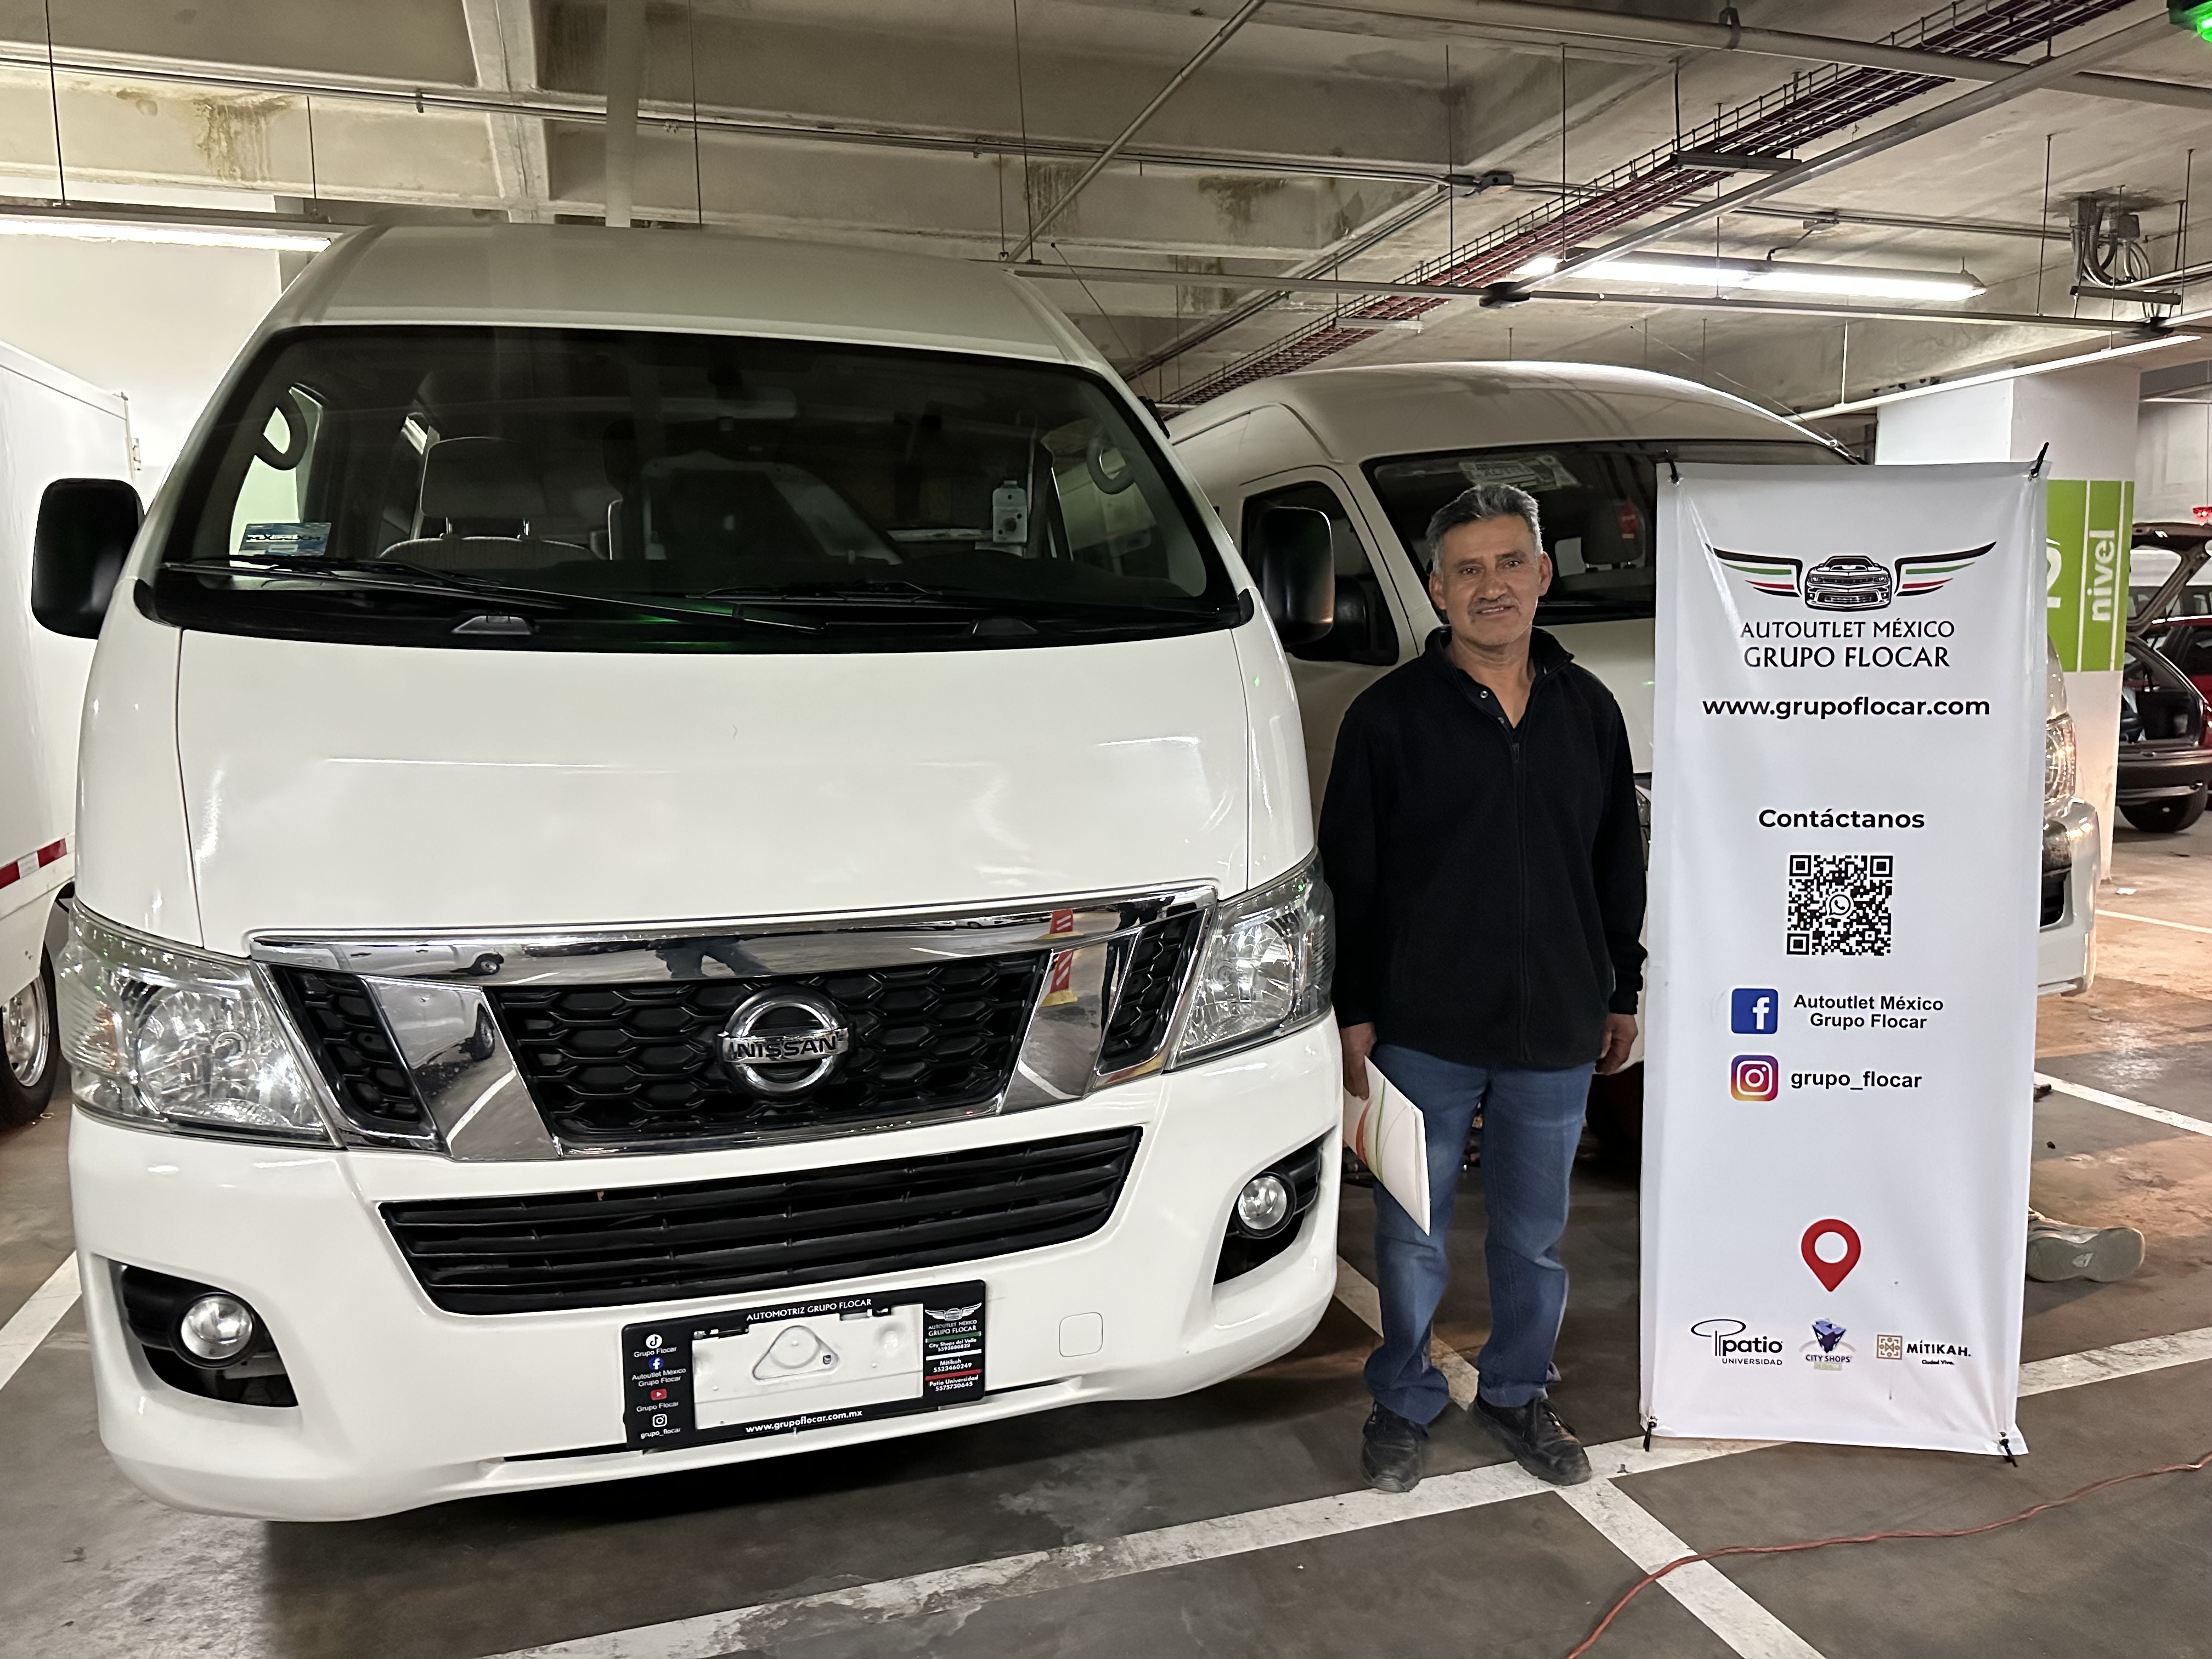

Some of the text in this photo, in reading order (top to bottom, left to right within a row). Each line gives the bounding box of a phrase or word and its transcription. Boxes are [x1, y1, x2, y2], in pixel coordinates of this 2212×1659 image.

[2087, 530, 2115, 621] nivel
[1740, 618, 1955, 638] AUTOUTLET MÉXICO
[1744, 646, 1950, 668] GRUPO FLOCAR
[1702, 697, 1990, 720] www.grupoflocar.com
[1759, 808, 1925, 828] Contáctanos
[1793, 995, 1944, 1011] Autoutlet México
[1810, 1013, 1927, 1030] Grupo Flocar
[737, 1036, 837, 1058] NISSAN
[1791, 1071, 1922, 1090] grupo_flocar
[746, 1299, 872, 1321] AUTOMOTRIZ GRUPO FLOCAR
[928, 1325, 977, 1336] GRUPO FLOCAR
[1722, 1336, 1782, 1356] patio
[933, 1363, 972, 1373] 5523460249
[939, 1358, 962, 1366] Mitikah
[632, 1371, 662, 1381] Autoutlet
[945, 1375, 979, 1384] Universidad
[935, 1381, 973, 1392] 5575730645
[746, 1410, 862, 1433] www.grupoflocar.com.mx
[640, 1427, 681, 1440] grupo_flocar
